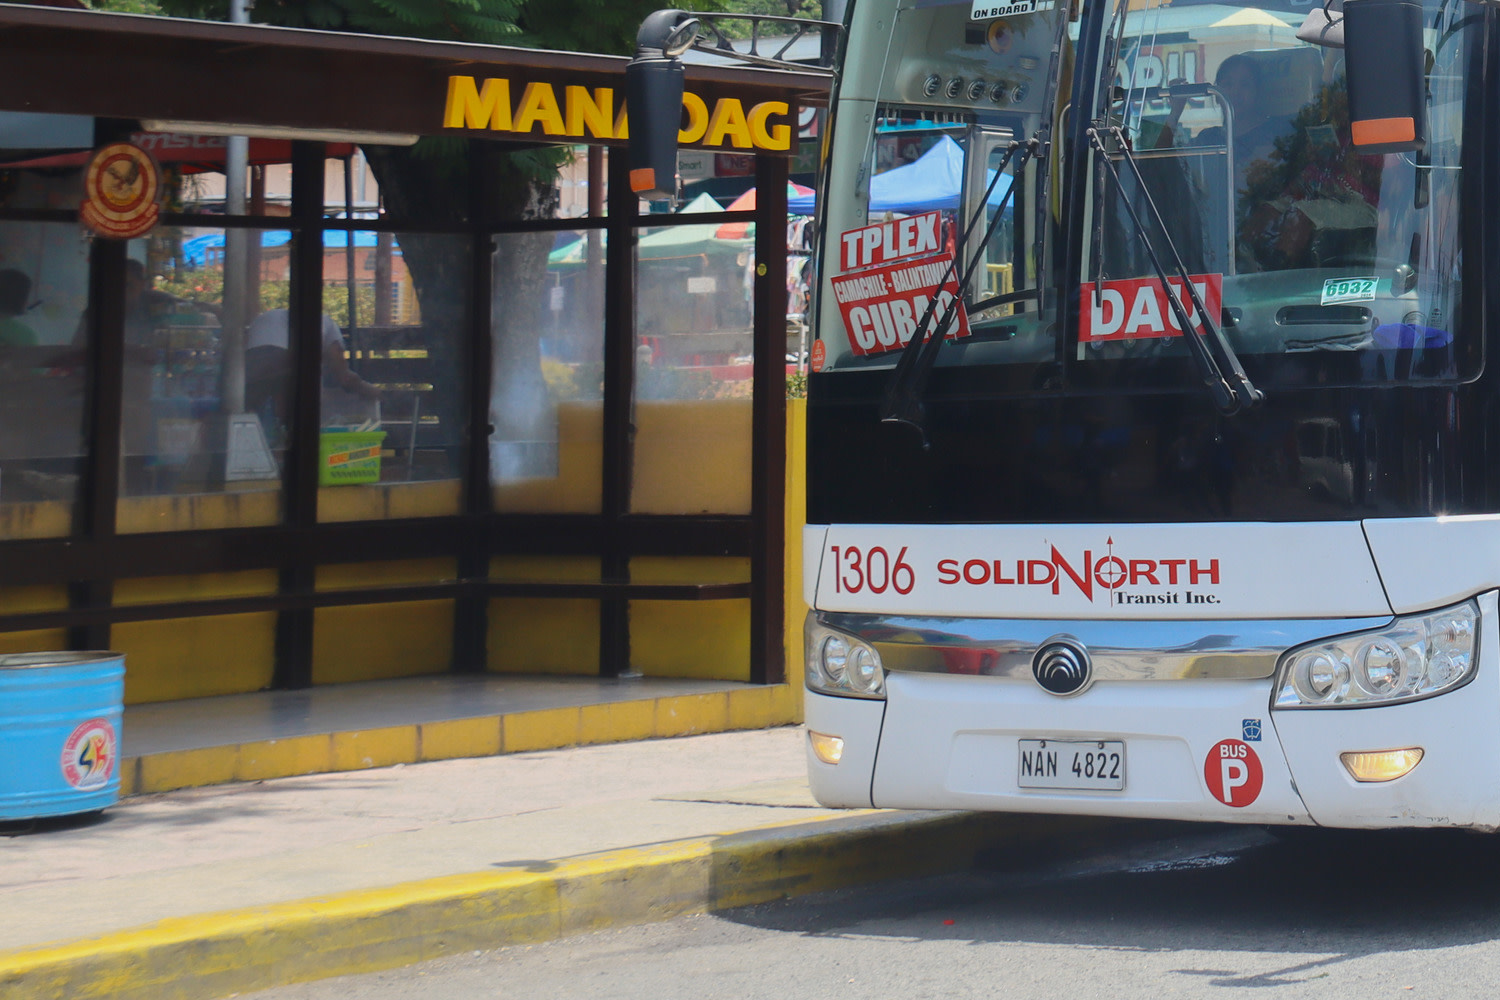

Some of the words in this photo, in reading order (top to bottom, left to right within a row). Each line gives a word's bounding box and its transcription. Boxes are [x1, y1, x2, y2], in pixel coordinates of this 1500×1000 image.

[974, 9, 988, 18] ON
[991, 3, 1028, 16] BOARD
[443, 75, 791, 150] MANOAG
[843, 213, 938, 269] TPLEX
[834, 273, 889, 304] CAMACHILE
[1326, 282, 1373, 296] 6932
[1090, 282, 1206, 336] DAU
[831, 545, 916, 595] 1306
[1113, 591, 1178, 605] Transit
[1186, 591, 1221, 605] Inc.
[1021, 751, 1057, 777] NAN
[1072, 752, 1120, 779] 4822
[1220, 744, 1247, 758] BUS
[1221, 758, 1248, 803] P
